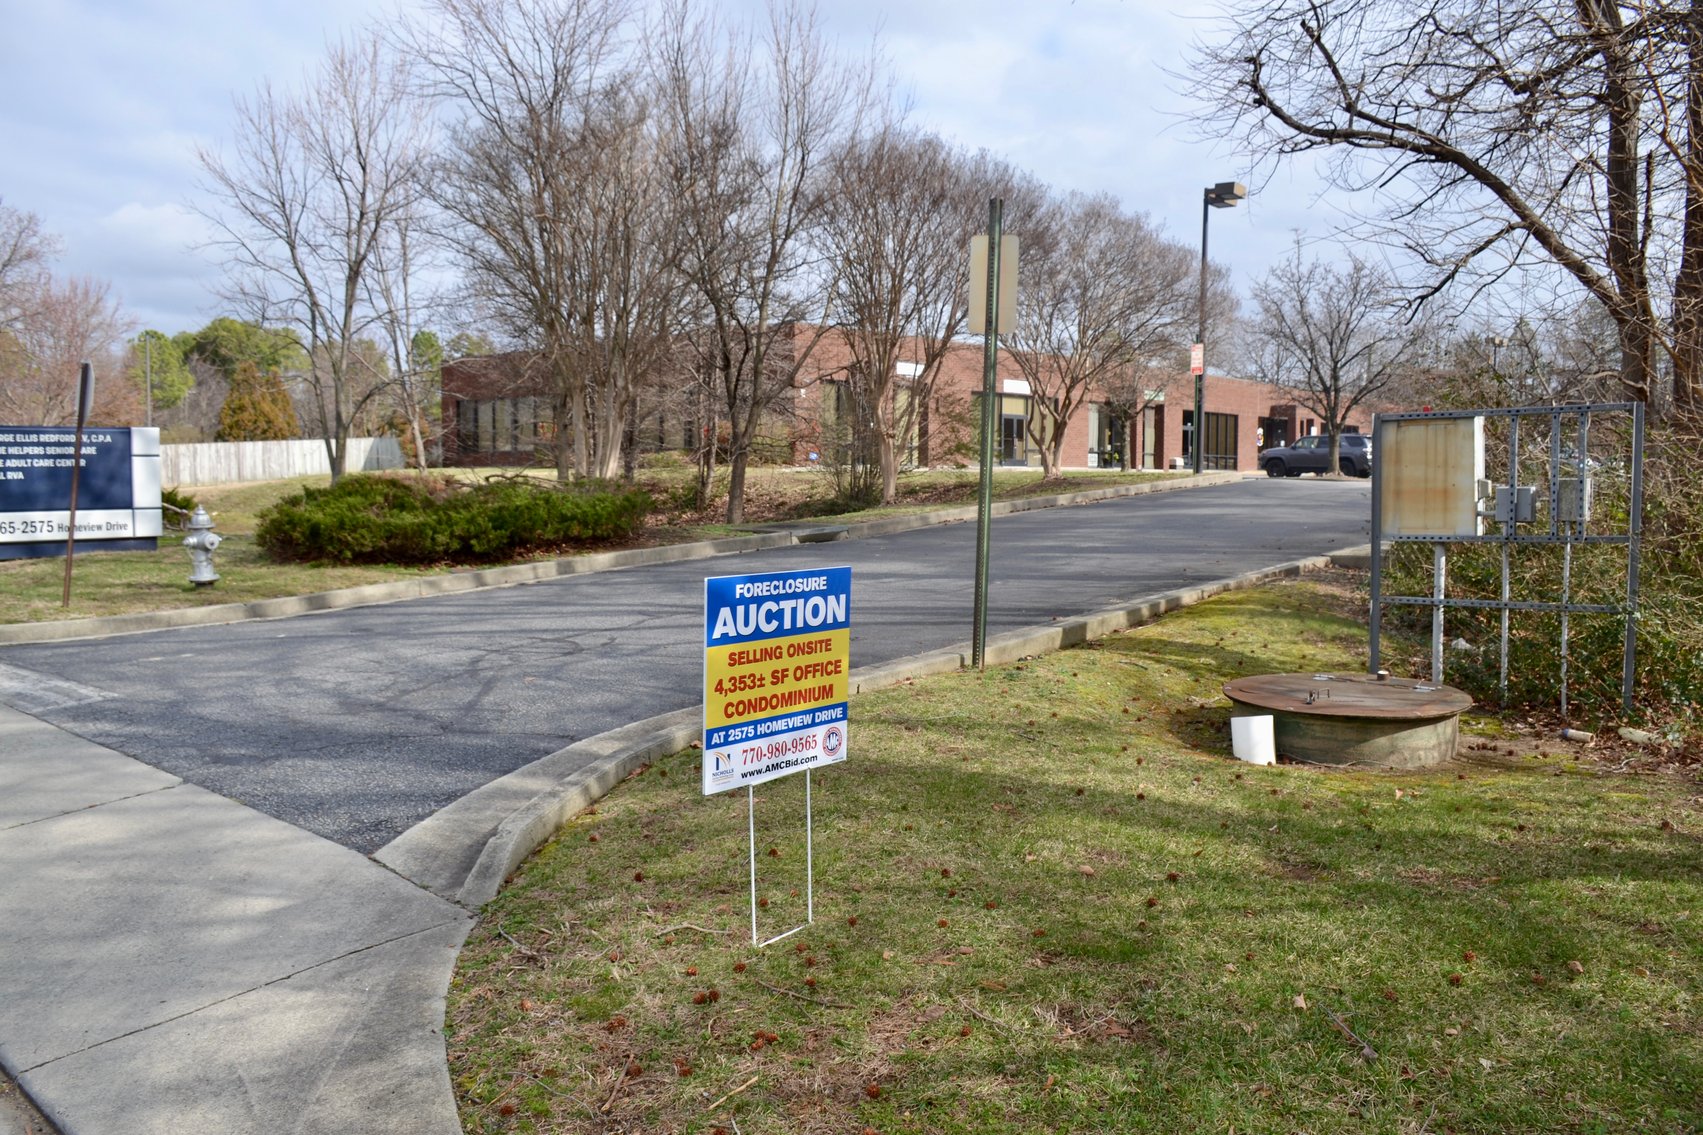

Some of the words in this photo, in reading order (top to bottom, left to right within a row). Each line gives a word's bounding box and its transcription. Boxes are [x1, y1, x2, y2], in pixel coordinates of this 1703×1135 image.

[7, 446, 44, 455] HELPERS
[45, 446, 75, 455] SENIOR
[79, 446, 97, 455] ARE
[16, 434, 38, 442] ELLIS
[39, 434, 76, 442] REDFORD
[5, 459, 32, 467] ADULT
[33, 459, 55, 467] CARE
[55, 459, 86, 467] CENTR
[6, 471, 24, 480] RVA
[106, 521, 128, 531] Drive
[735, 576, 827, 599] FORECLOSURE
[712, 594, 846, 640] AUCTION
[728, 645, 782, 667] SELLING
[787, 638, 832, 658] ONSITE
[714, 673, 766, 697] 4,353±
[770, 668, 789, 687] SF
[793, 659, 842, 682] OFFICE
[724, 684, 834, 719] CONDOMINIUM
[711, 731, 726, 746] AT
[728, 725, 755, 742] 2575
[757, 715, 813, 734] HOMEVIEW
[815, 707, 843, 721] DRIVE
[742, 733, 818, 766] 770-980-9565
[741, 754, 818, 779] www.AMCBid.com
